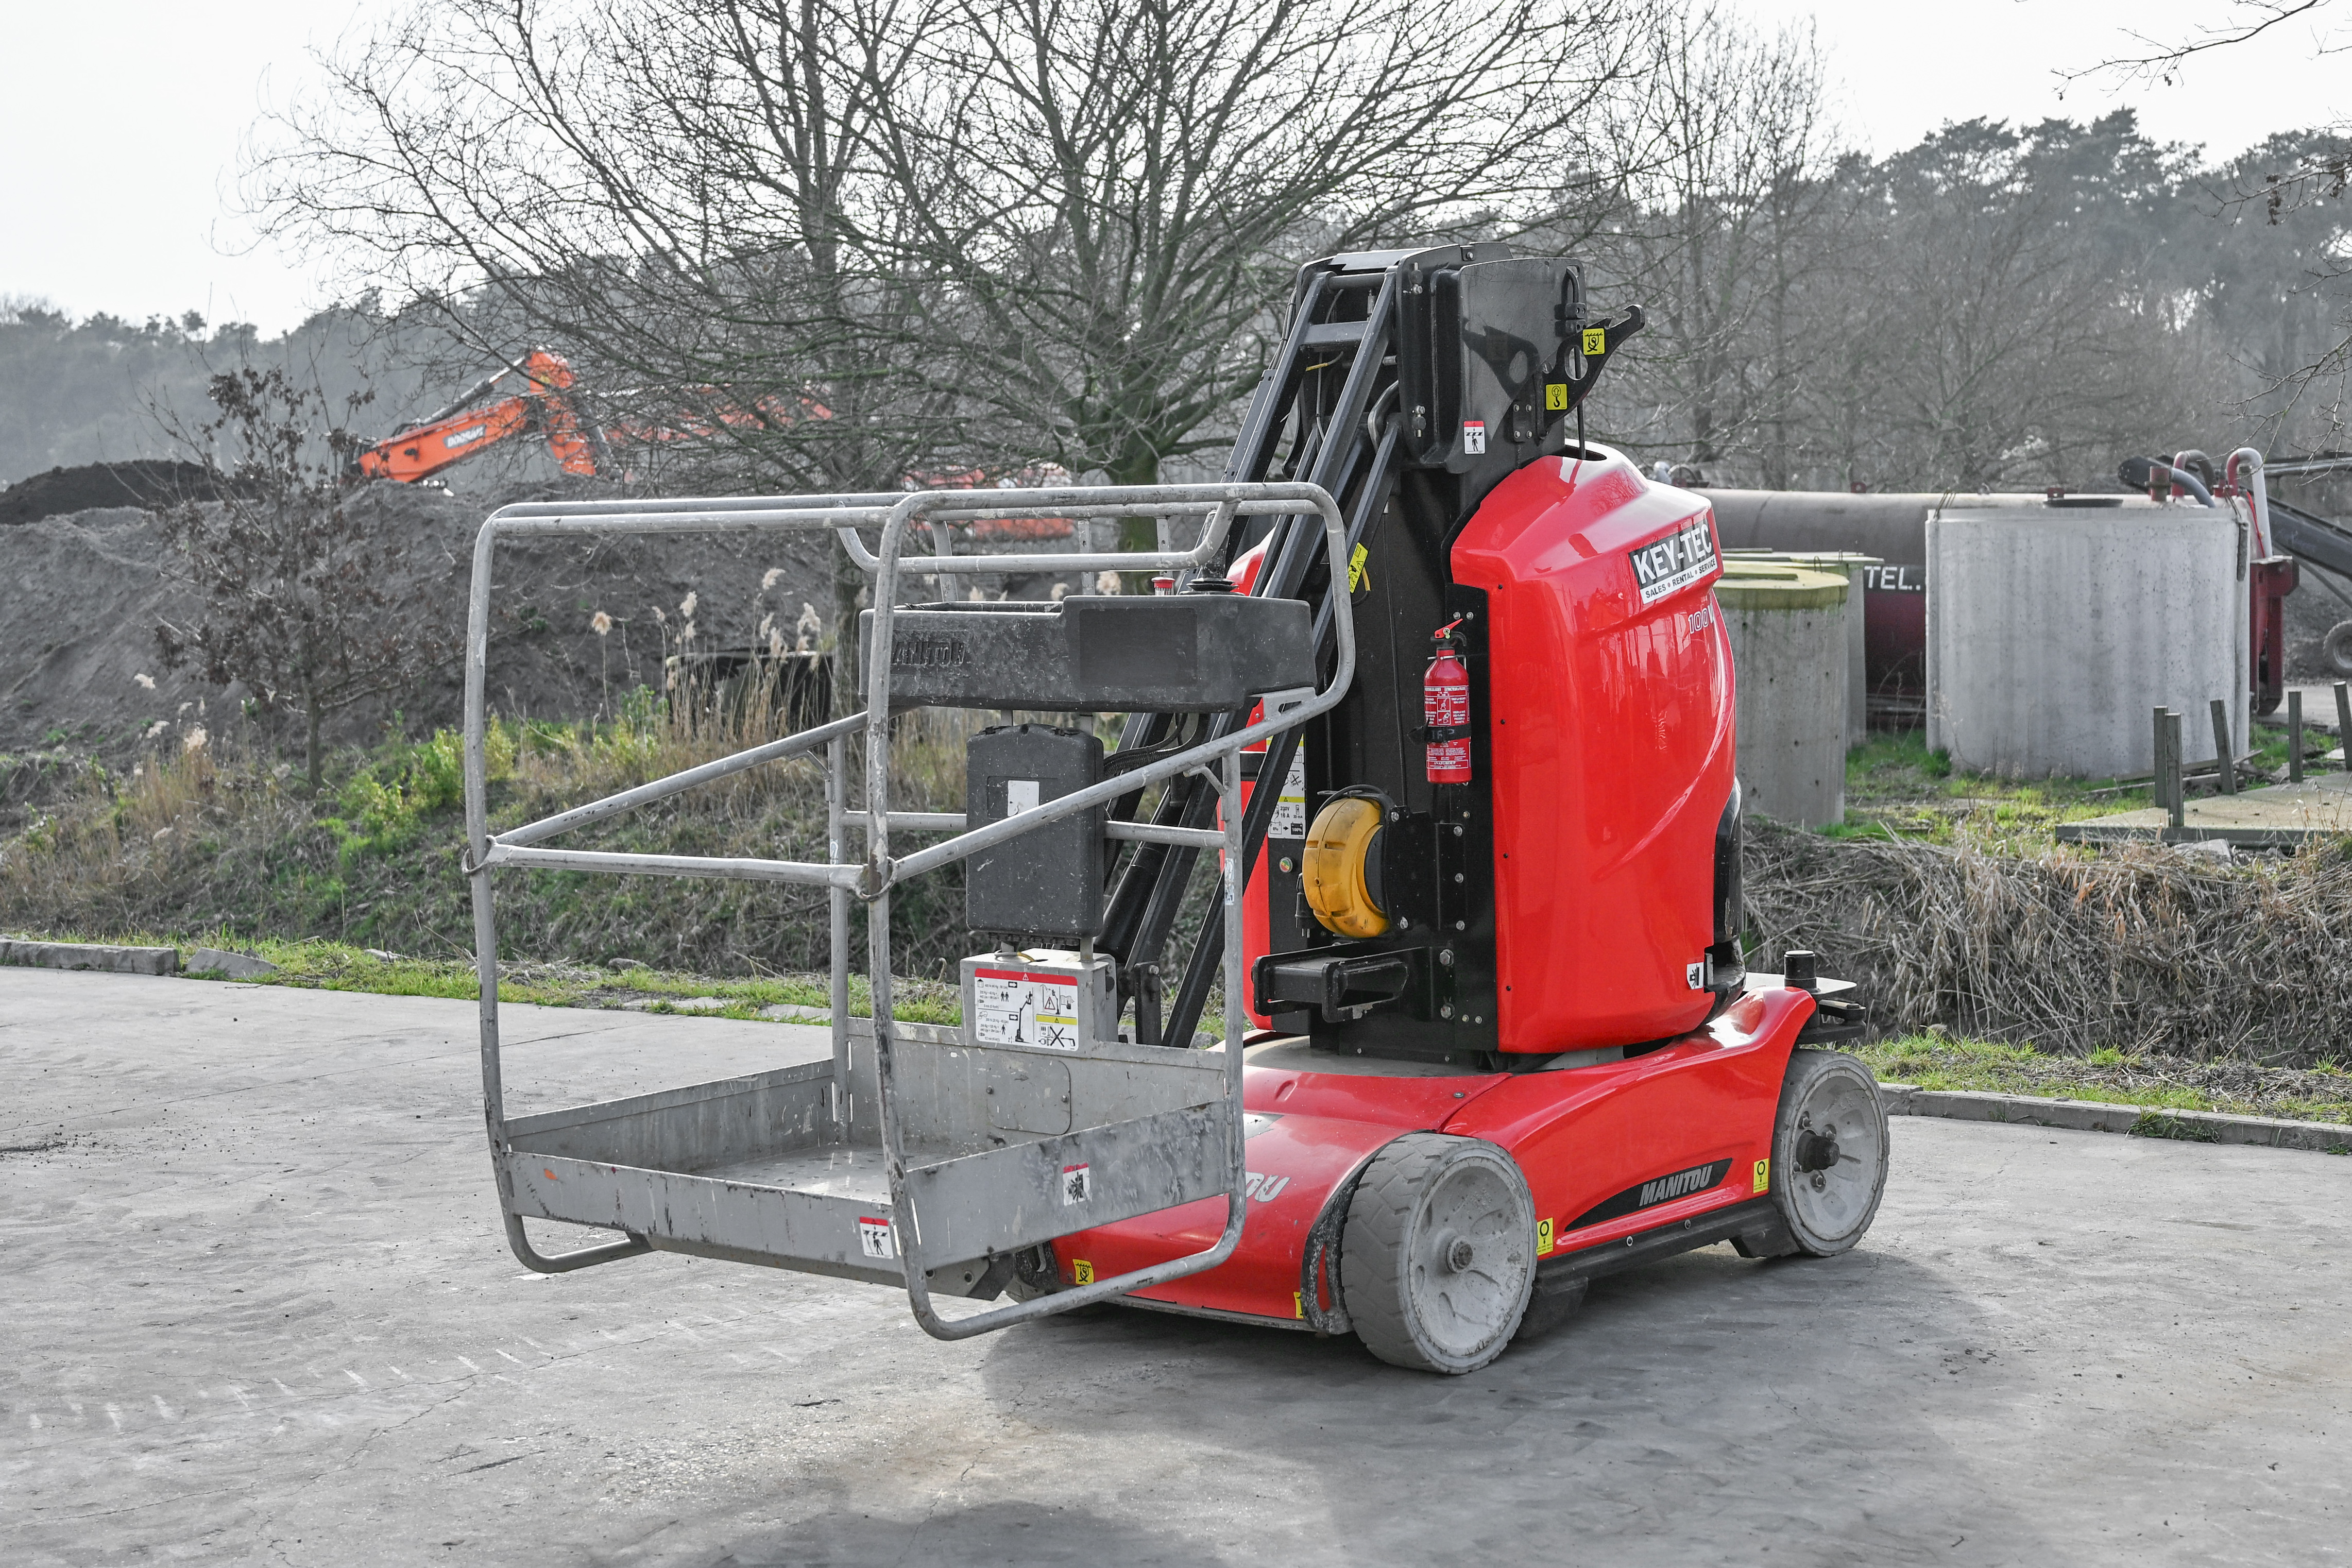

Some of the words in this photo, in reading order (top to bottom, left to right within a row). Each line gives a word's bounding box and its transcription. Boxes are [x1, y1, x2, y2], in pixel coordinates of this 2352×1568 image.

[1633, 524, 1714, 584] KEY-TEC
[1645, 584, 1666, 599] SALES
[1672, 572, 1694, 587] RENTAL
[1698, 558, 1716, 574] SERVICE
[1864, 566, 1921, 590] TEL.
[891, 641, 966, 667] ANITOU
[1639, 1165, 1712, 1206] MANITOU
